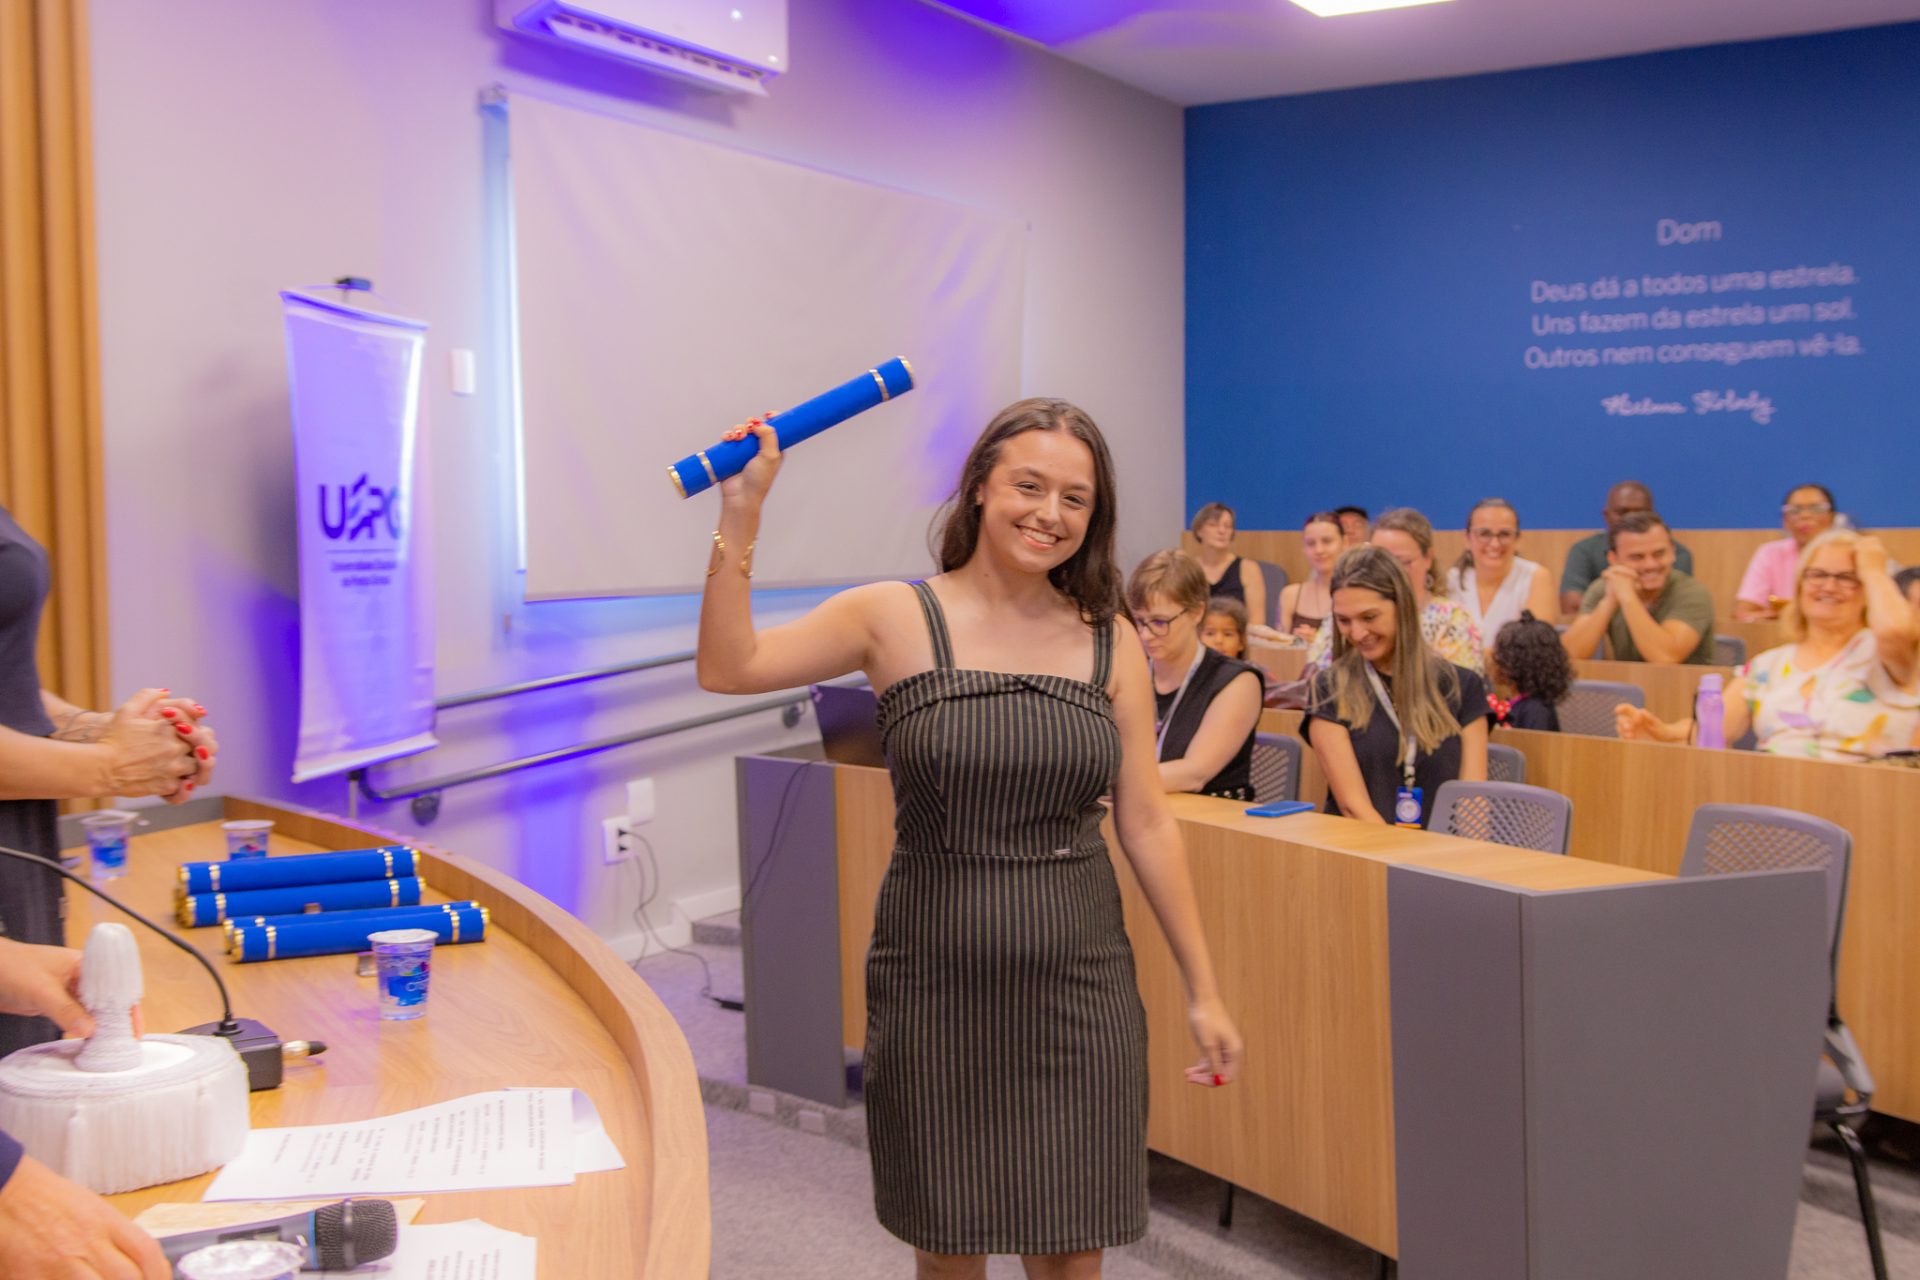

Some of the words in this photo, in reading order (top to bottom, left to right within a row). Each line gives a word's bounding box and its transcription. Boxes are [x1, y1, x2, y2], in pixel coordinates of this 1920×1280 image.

[1656, 218, 1722, 246] Dom
[1530, 279, 1587, 303] Deus
[1590, 275, 1620, 299] dá
[1622, 278, 1639, 298] a
[1642, 272, 1708, 296] todos
[1710, 270, 1767, 293] uma
[1531, 313, 1576, 336] Uns
[1579, 310, 1648, 333] fazem
[1651, 306, 1682, 330] da
[1685, 301, 1766, 328] estrela
[1768, 303, 1811, 324] um
[1524, 346, 1599, 369] Outros
[1602, 345, 1654, 365] nem
[1656, 338, 1795, 365] conseguem
